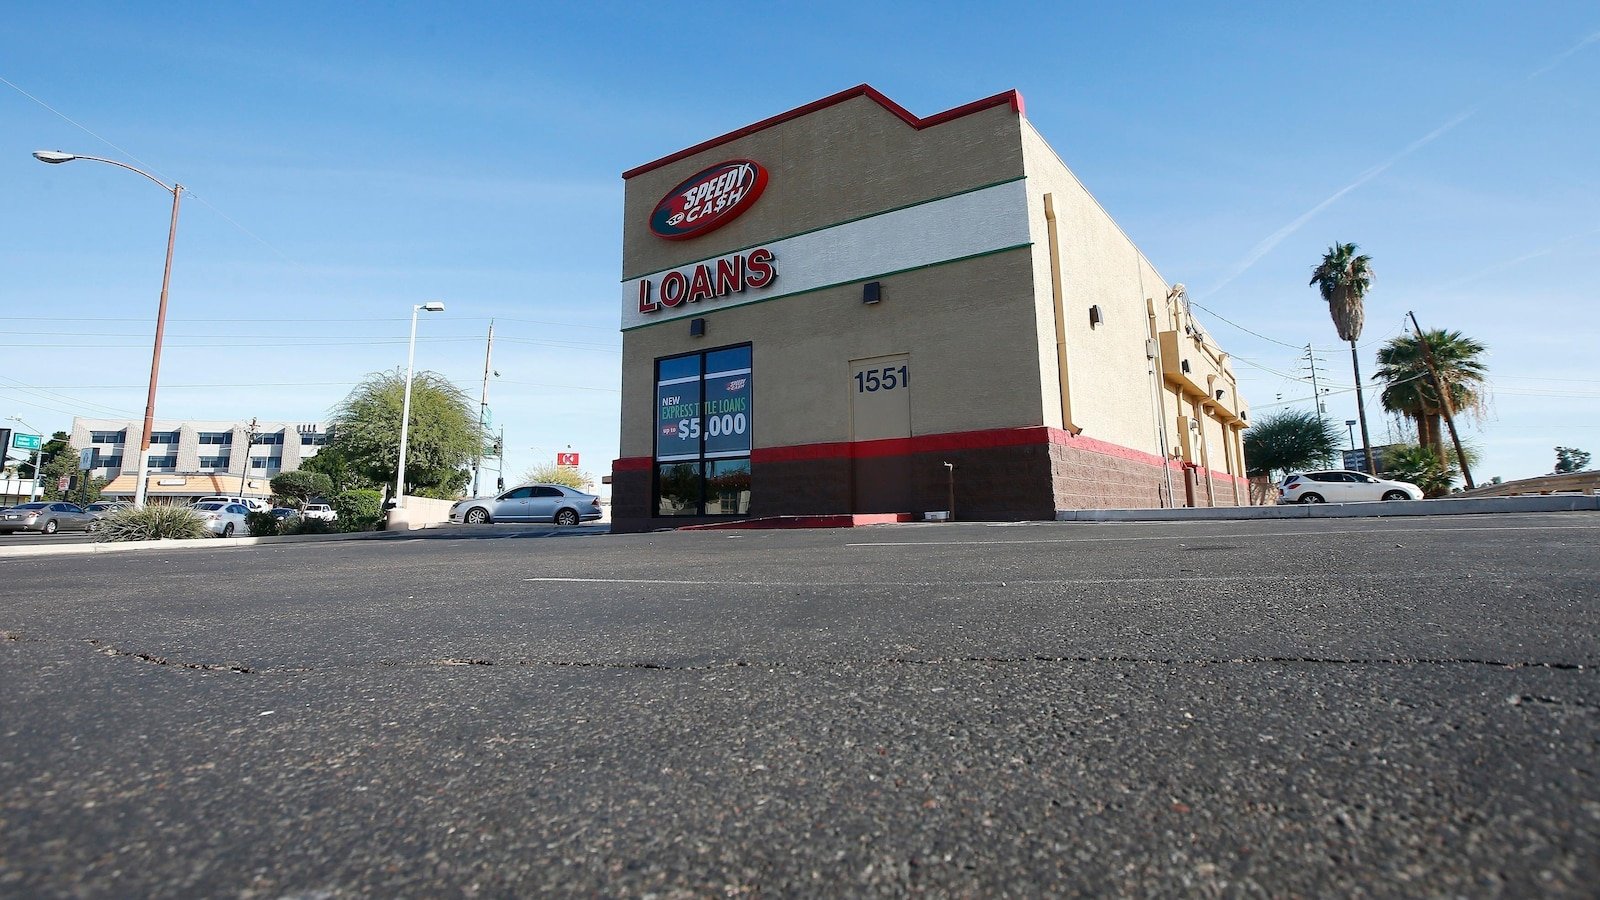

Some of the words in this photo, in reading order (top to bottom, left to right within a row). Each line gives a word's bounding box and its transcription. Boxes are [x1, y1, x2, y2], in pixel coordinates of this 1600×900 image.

[681, 163, 750, 210] SPEEDY
[686, 187, 744, 222] CA$H
[638, 248, 776, 313] LOANS
[854, 366, 907, 392] 1551
[662, 396, 680, 406] NEW
[662, 403, 694, 419] EXPRESS
[695, 402, 717, 415] TTLE
[720, 398, 746, 413] LOANS
[678, 414, 746, 440] $5,000
